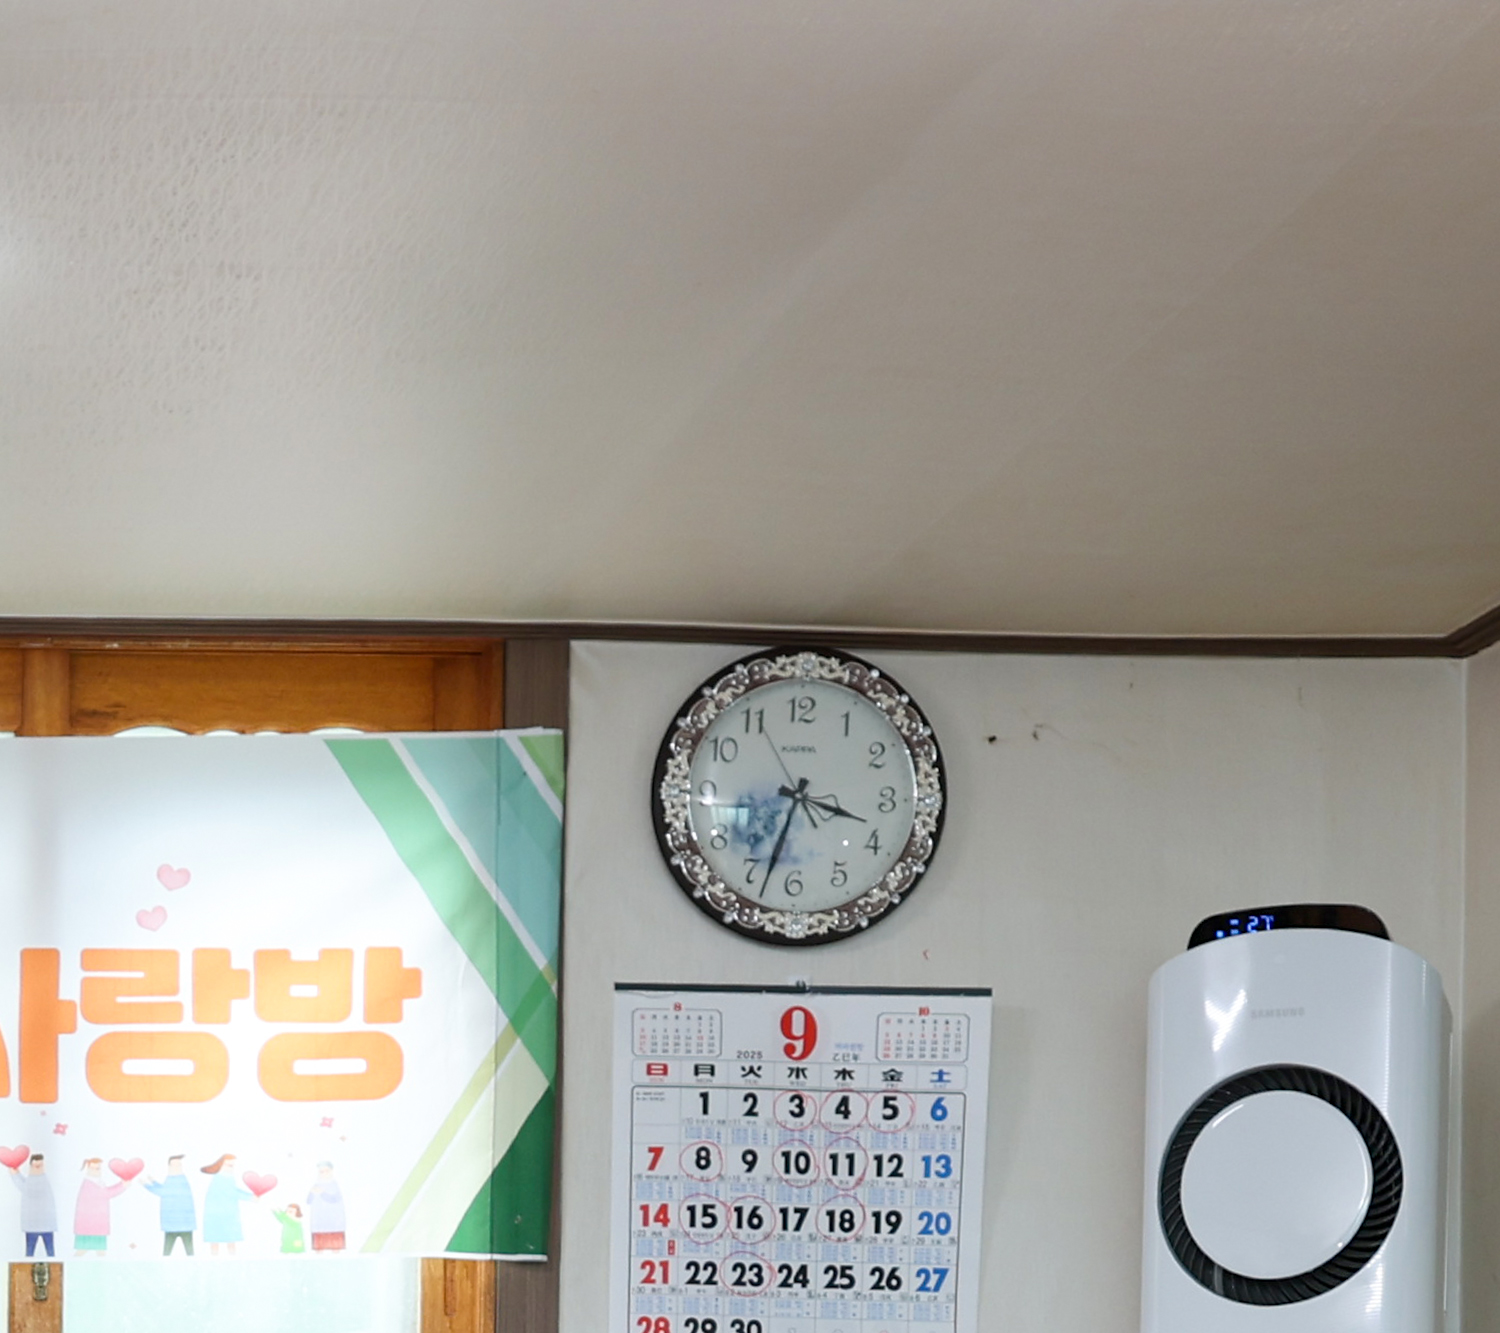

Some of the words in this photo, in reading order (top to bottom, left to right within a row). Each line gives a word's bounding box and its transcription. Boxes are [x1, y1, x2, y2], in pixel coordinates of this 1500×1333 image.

[741, 708, 764, 734] 11
[788, 696, 816, 724] 12
[841, 712, 850, 737] 1
[710, 736, 738, 763] 10
[868, 742, 886, 769] 2
[878, 786, 896, 813] 3
[710, 824, 728, 850] 8
[865, 828, 882, 856] 4
[744, 858, 759, 884] 7
[784, 870, 803, 896] 6
[830, 861, 848, 887] 5
[1250, 1007, 1305, 1019] SAMSUNG
[780, 1006, 817, 1061] 9
[736, 1050, 763, 1059] 2025
[646, 1063, 668, 1076] 日
[694, 1063, 715, 1077] 月
[740, 1065, 762, 1078] 火
[787, 1066, 808, 1080] 水
[833, 1067, 855, 1081] 木
[881, 1068, 904, 1082] 金
[929, 1069, 952, 1083] 土
[699, 1091, 709, 1115] 1
[743, 1092, 759, 1117] 2
[789, 1093, 805, 1118] 3
[835, 1095, 851, 1120] 4
[882, 1095, 899, 1121] 5
[930, 1097, 948, 1122] 6
[649, 1146, 664, 1170] 7
[695, 1146, 711, 1171] 8
[741, 1149, 758, 1173] 9
[781, 1150, 811, 1175] 10
[829, 1153, 855, 1177] 11
[873, 1153, 904, 1178] 12
[921, 1154, 953, 1180] 13
[641, 1203, 671, 1227] 14
[686, 1204, 718, 1229] 15
[733, 1205, 764, 1230] 16
[779, 1207, 809, 1232] 17
[826, 1209, 855, 1233] 18
[871, 1210, 902, 1235] 19
[918, 1210, 952, 1236] 20
[641, 1260, 670, 1284] 21
[685, 1260, 718, 1286] 22
[732, 1262, 764, 1287] 23
[777, 1263, 810, 1288] 24
[823, 1265, 856, 1290] 25
[869, 1266, 902, 1291] 26
[916, 1267, 950, 1293] 27
